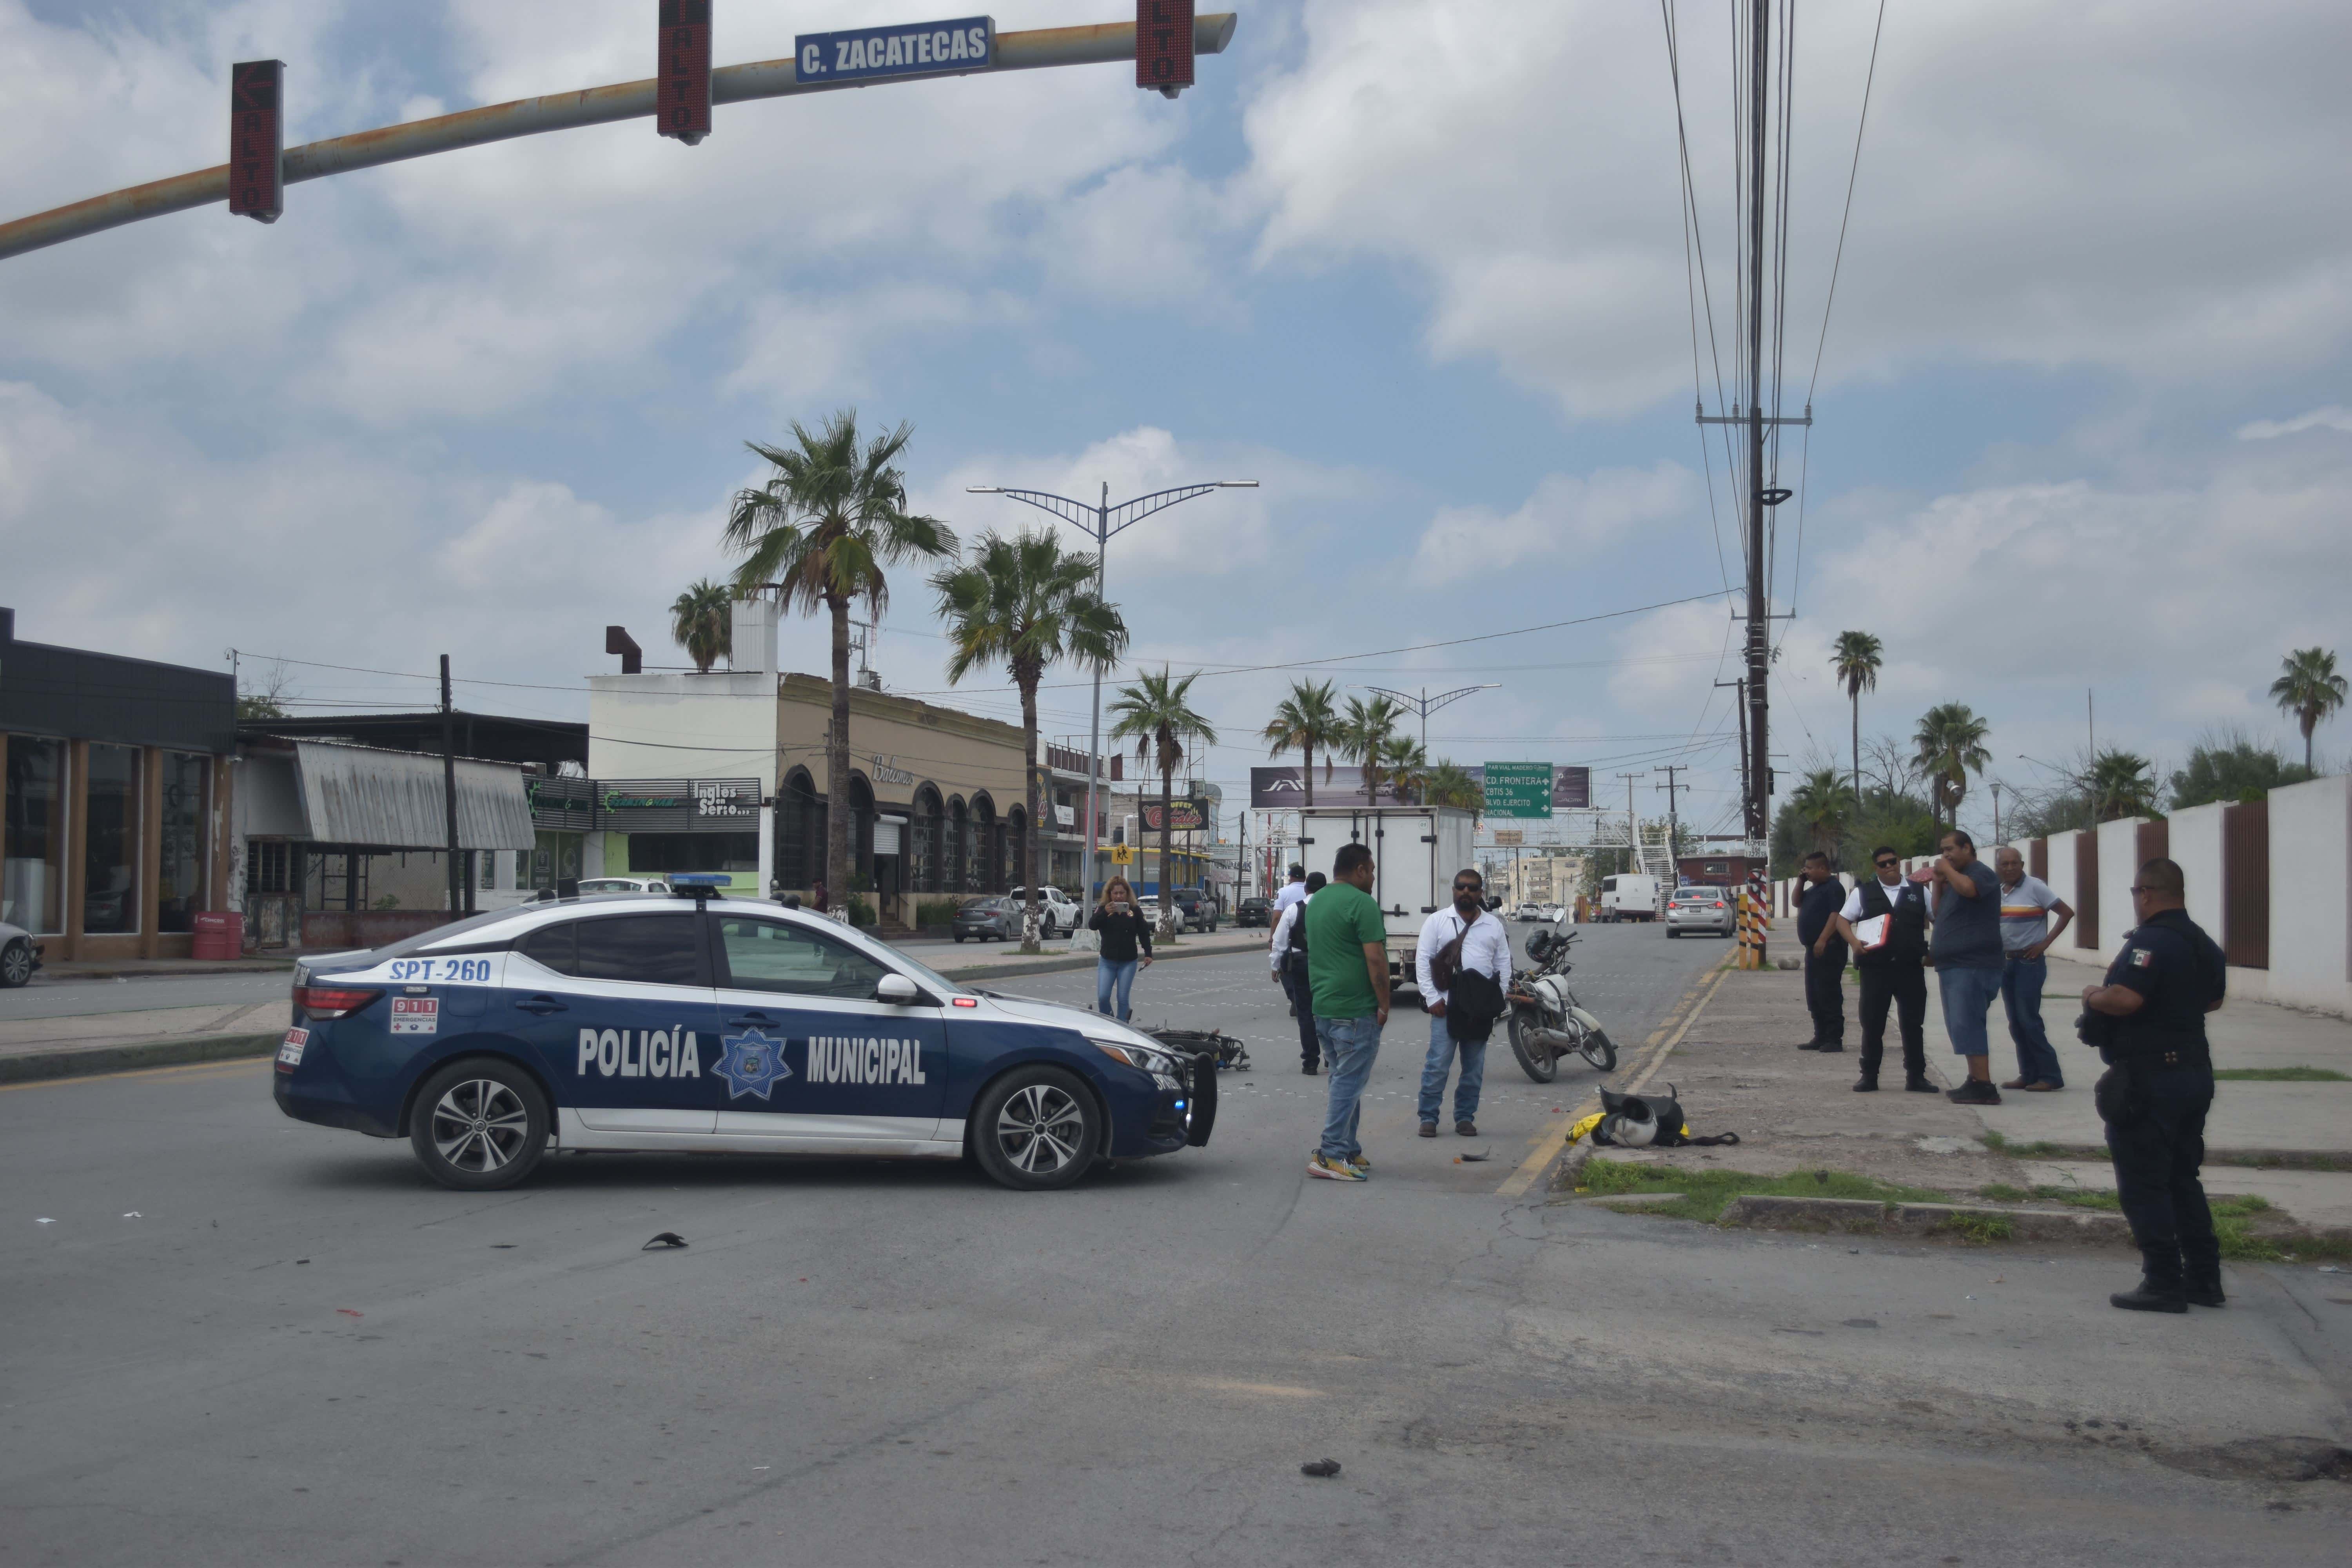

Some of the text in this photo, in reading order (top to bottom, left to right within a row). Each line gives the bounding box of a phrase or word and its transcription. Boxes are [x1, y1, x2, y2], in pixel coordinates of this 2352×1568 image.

[802, 27, 986, 74] C. ZACATECAS
[1152, 0, 1174, 80] LTO
[671, 27, 693, 128] ALTO
[241, 114, 260, 209] ALTO
[695, 783, 737, 805] Ingles
[1500, 777, 1542, 785] FRONTERA
[389, 960, 491, 981] SPT-260
[397, 1001, 433, 1011] 911
[287, 1031, 305, 1043] 911
[578, 1024, 926, 1085] POLICÍA MUNICIPAL
